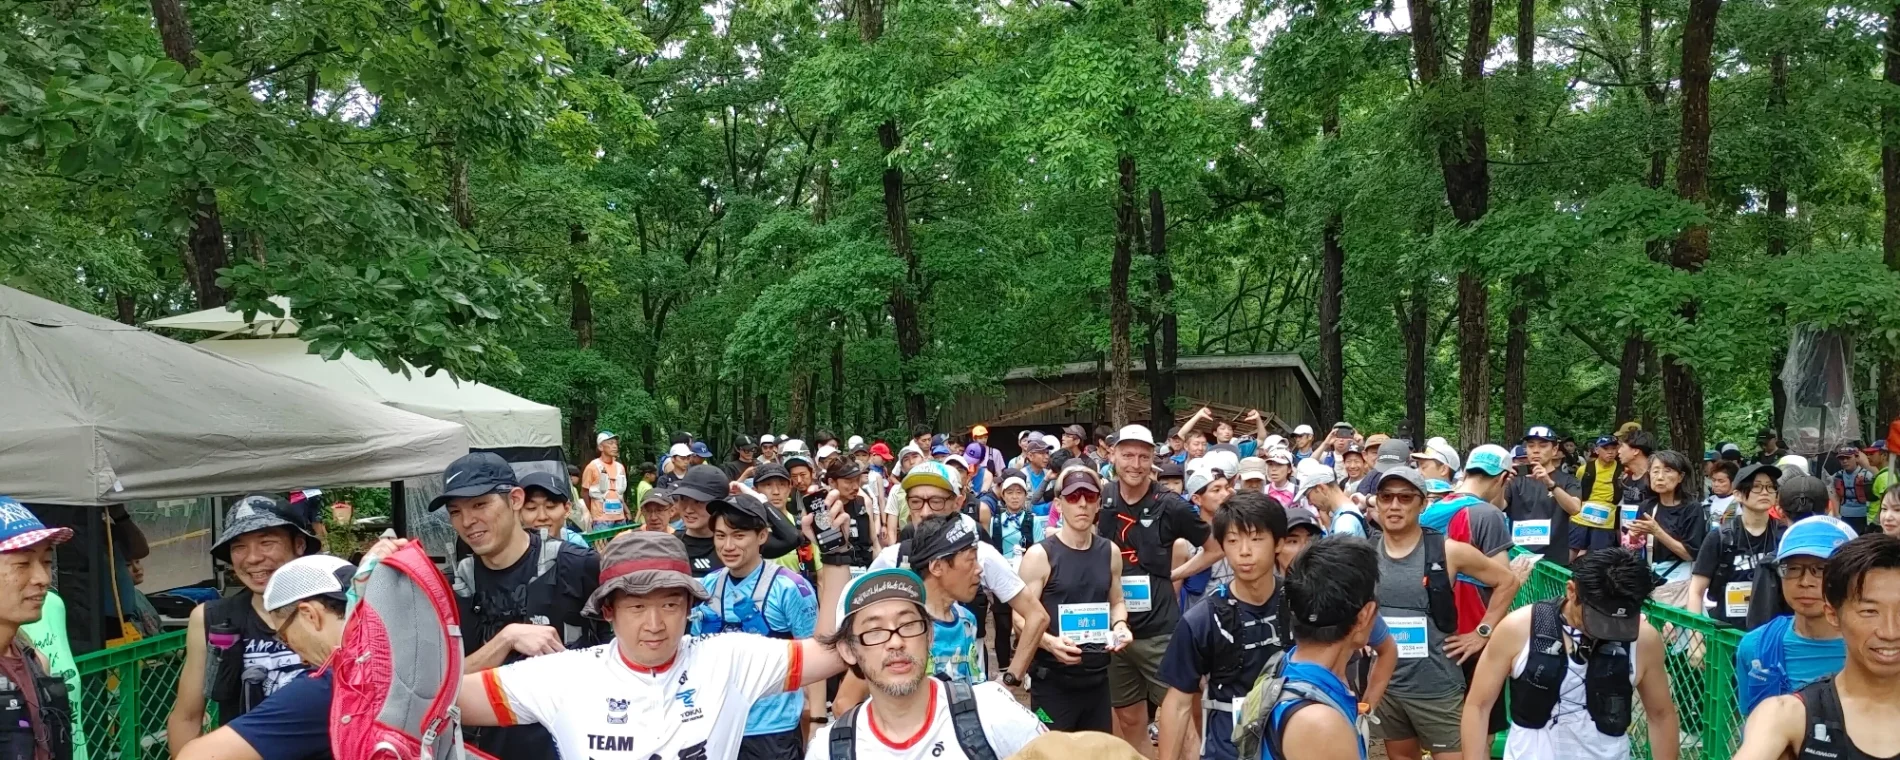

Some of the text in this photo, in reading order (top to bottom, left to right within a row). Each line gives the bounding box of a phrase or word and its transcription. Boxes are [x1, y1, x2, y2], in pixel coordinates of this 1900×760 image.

[243, 639, 274, 653] AMP
[587, 733, 635, 752] TEAM
[1804, 747, 1838, 758] SALOMON
